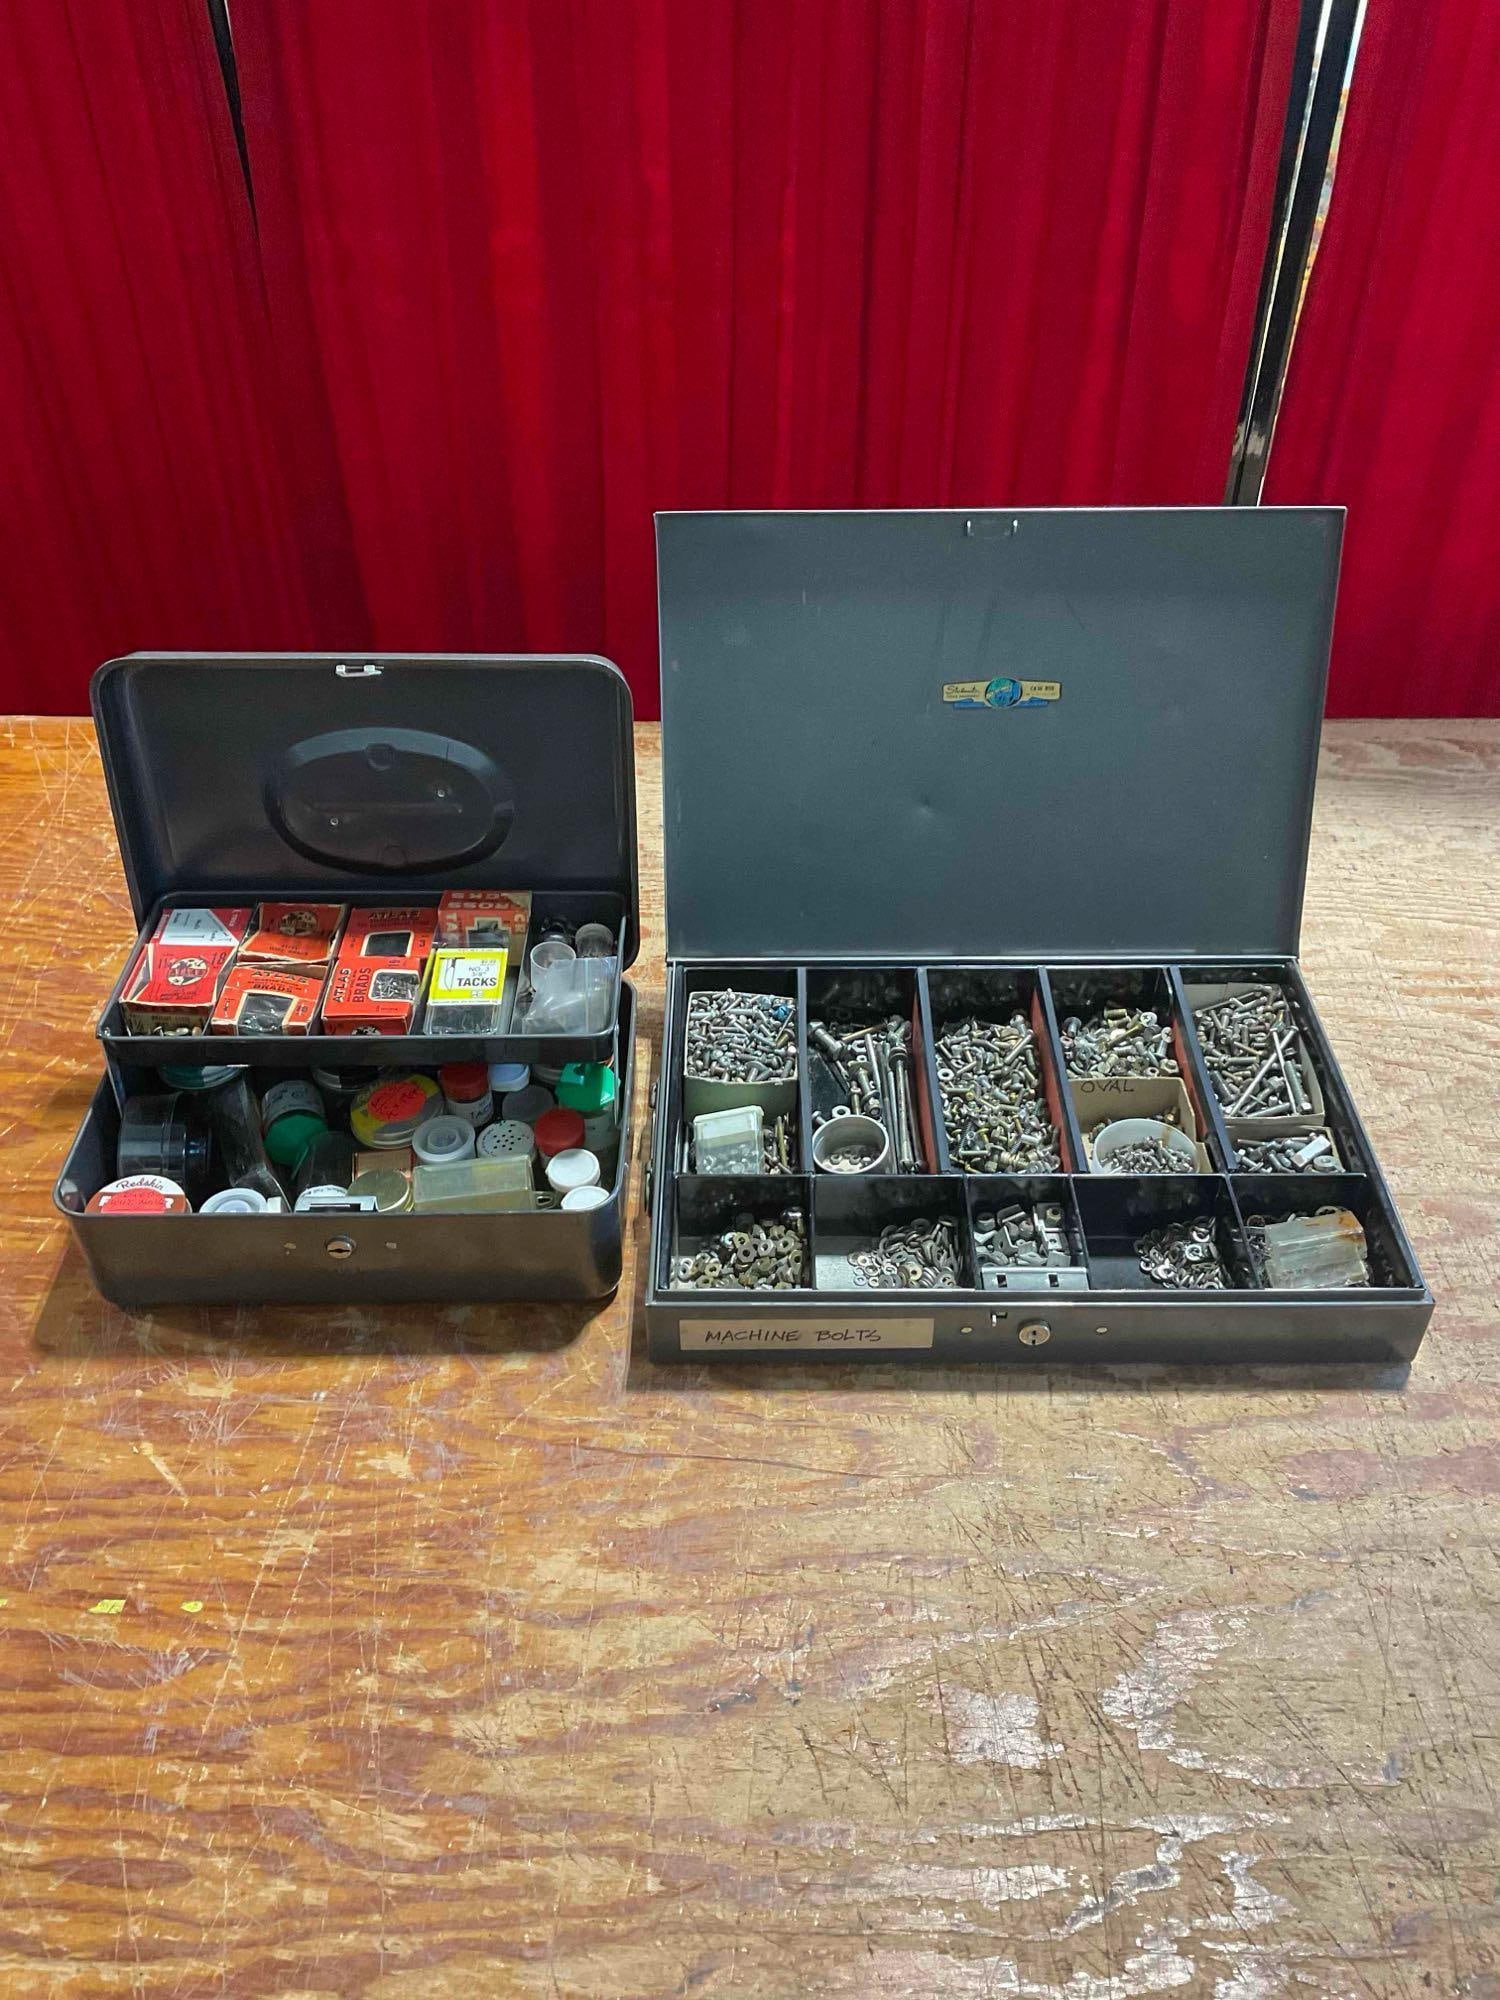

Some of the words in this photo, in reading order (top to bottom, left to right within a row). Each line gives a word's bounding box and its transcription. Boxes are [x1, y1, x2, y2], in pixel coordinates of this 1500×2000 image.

[251, 970, 309, 985] ATLAS
[352, 967, 372, 1003] BRADS
[457, 977, 497, 987] TACKS
[253, 983, 293, 993] BRADS
[333, 968, 352, 1003] ATLAS
[1081, 1079, 1135, 1094] OVAL
[116, 1177, 164, 1190] Redskin
[705, 1329, 800, 1344] MACHINE
[816, 1329, 881, 1342] BOLTS
